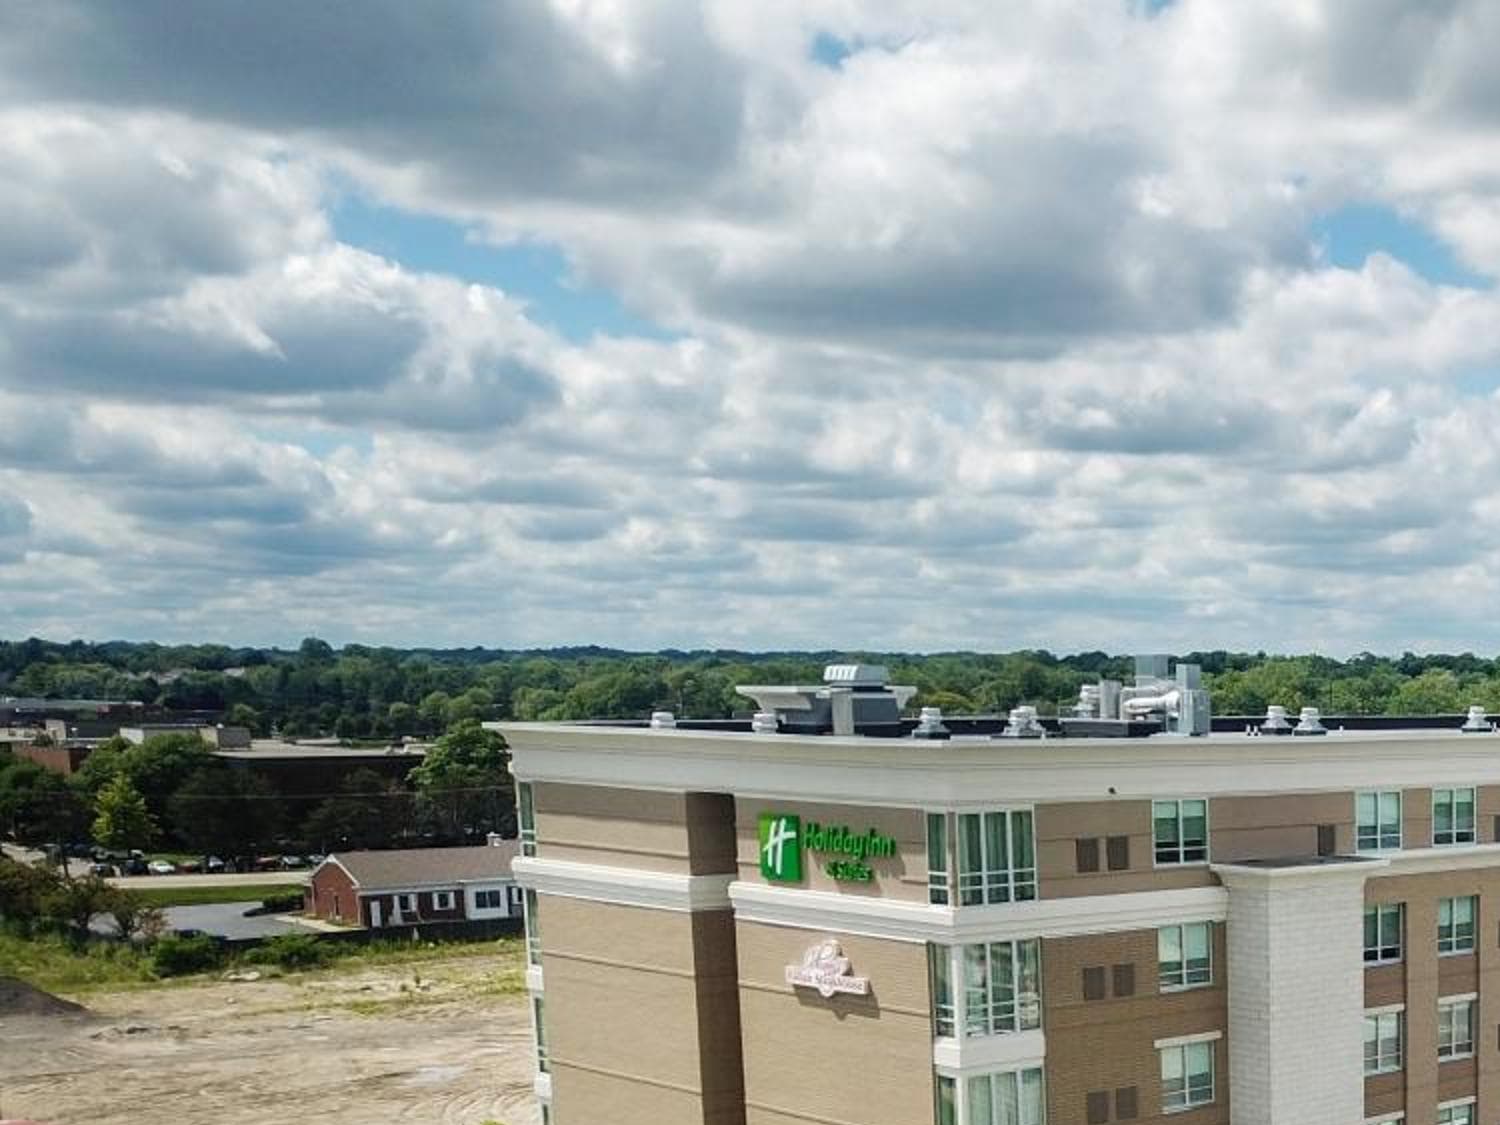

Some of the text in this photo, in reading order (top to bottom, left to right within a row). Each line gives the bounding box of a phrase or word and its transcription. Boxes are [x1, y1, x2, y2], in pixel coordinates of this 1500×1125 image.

[762, 817, 797, 875] H
[803, 822, 897, 860] Holiday Inn
